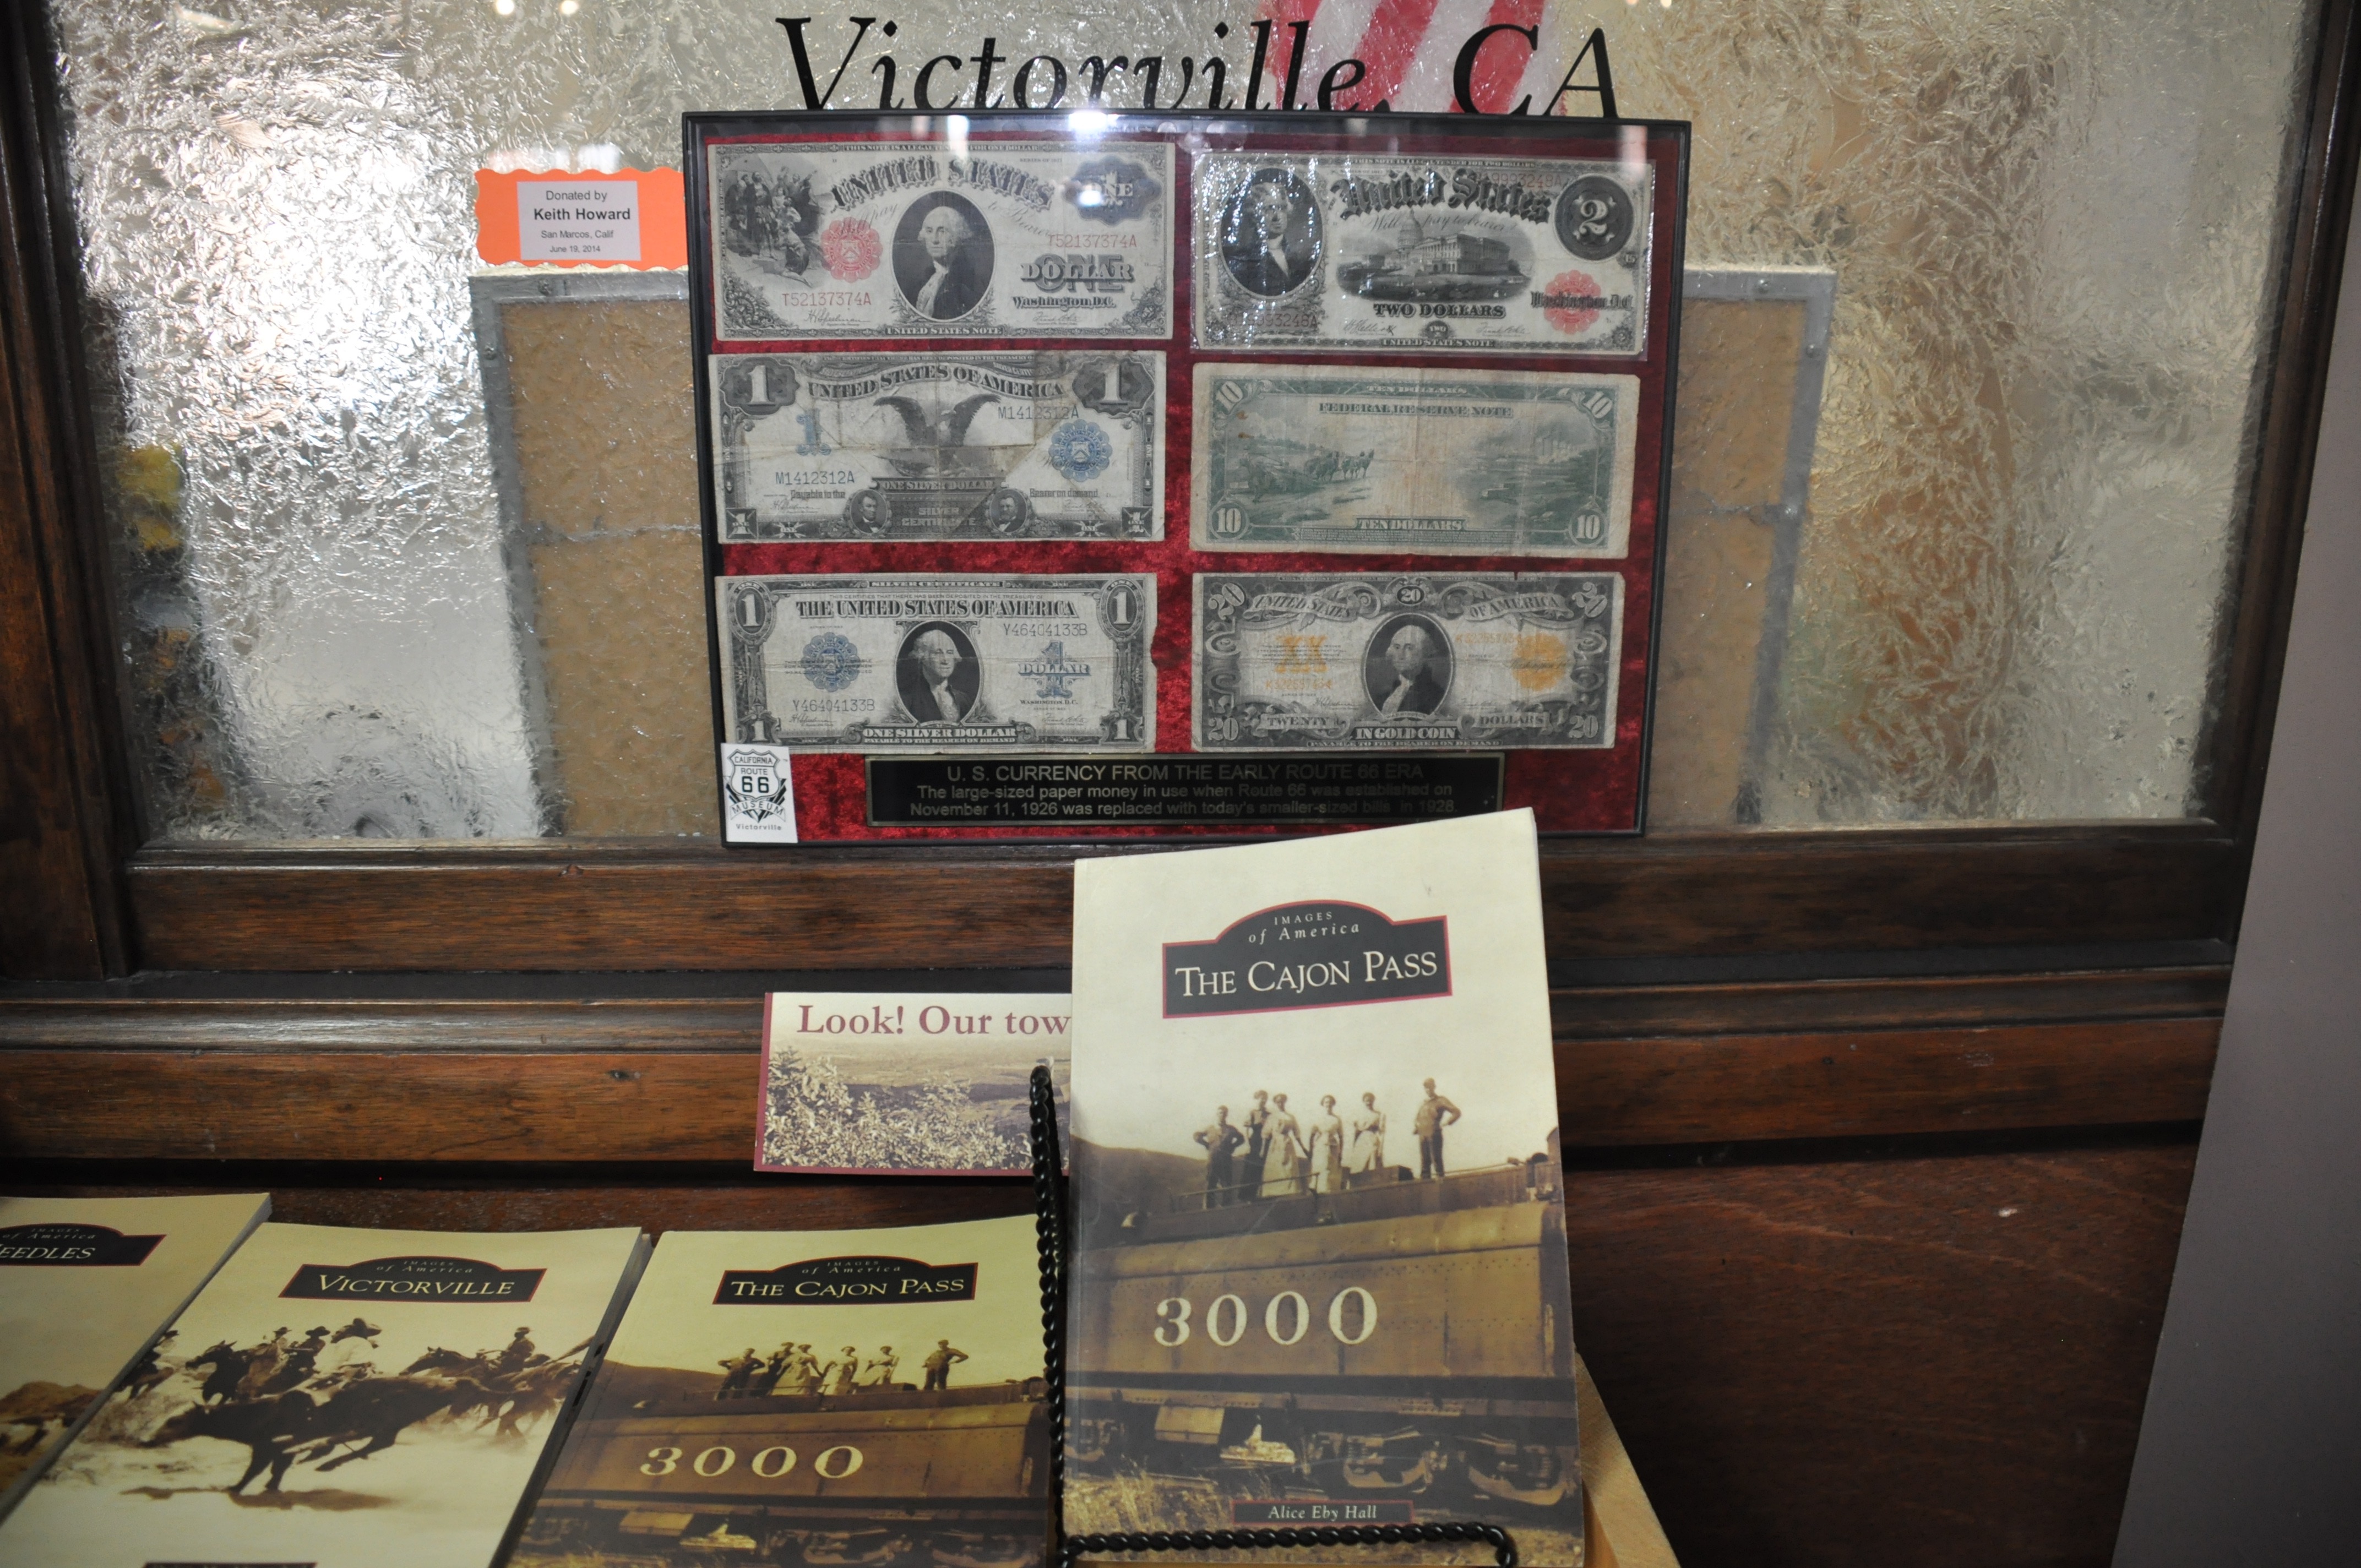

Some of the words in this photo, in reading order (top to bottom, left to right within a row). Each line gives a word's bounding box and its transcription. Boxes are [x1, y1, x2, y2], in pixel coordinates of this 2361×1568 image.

[1454, 24, 1620, 117] CA
[831, 155, 942, 214] UNITED
[546, 190, 591, 200] Donated
[594, 190, 607, 202] by
[534, 208, 570, 220] Keith
[575, 208, 631, 220] Howard
[1578, 199, 1608, 236] 2
[541, 230, 558, 238] San
[559, 230, 592, 239] Marcos,
[595, 230, 614, 238] Calif
[1047, 234, 1137, 248] T52137374A
[569, 245, 580, 253] 19,
[1020, 263, 1136, 283] DOLLAR
[1034, 253, 1125, 293] ONE
[782, 292, 872, 307] T52137374A
[1373, 303, 1416, 318] TWO
[1419, 304, 1506, 319] DOLLARS
[1423, 339, 1464, 347] STATES
[747, 364, 775, 406] 1
[807, 379, 876, 398] UNITED
[880, 364, 951, 388] STATES
[953, 367, 980, 384] OF
[980, 373, 1065, 398] AMERICA
[1100, 364, 1128, 406] 1
[1216, 380, 1244, 408] 10
[998, 406, 1079, 420] M1412312A
[1319, 403, 1391, 414] FEDERAL
[1393, 404, 1470, 417] RESERVE
[1471, 406, 1514, 418] NOTE
[1583, 391, 1613, 419] 10
[775, 470, 855, 485] M1412312A
[884, 481, 904, 489] ONE
[906, 481, 946, 489] SILVER
[918, 507, 959, 515] SILVER
[1216, 508, 1242, 533] 10
[1360, 520, 1389, 529] TEN
[1392, 520, 1462, 530] DOLLARS
[1576, 514, 1600, 539] 10
[1208, 582, 1245, 620] 20
[1255, 595, 1307, 609] UNITED
[1400, 589, 1421, 602] 20
[1571, 581, 1608, 618] 20
[741, 594, 760, 627] 1
[796, 601, 834, 619] THE
[837, 600, 903, 618] UNITED
[905, 600, 970, 618] STATES
[971, 600, 995, 618] OF
[995, 600, 1080, 619] AMERICA
[1113, 591, 1130, 624] 1
[1469, 606, 1486, 618] OF
[1489, 596, 1560, 616] AMERICA
[1003, 623, 1087, 636] Y46404133B
[1018, 663, 1092, 677] DOLLAR
[793, 698, 875, 712] Y46404133B
[1113, 719, 1130, 740] 1
[1208, 717, 1239, 741] 20
[1268, 716, 1330, 728] TWENTY
[1479, 715, 1544, 726] DOLLARS
[1568, 715, 1598, 739] 20
[751, 721, 767, 742] 1
[862, 728, 894, 737] ONE
[895, 728, 953, 737] SILVER
[955, 728, 1018, 737] DOLLAR
[1355, 727, 1373, 739] IN
[1374, 727, 1417, 739] GOLD
[1417, 727, 1458, 739] COIN
[734, 756, 773, 764] CALIFORNIA
[947, 766, 966, 781] U.
[972, 766, 989, 781] S.
[995, 765, 1103, 782] CURRENCY
[1112, 765, 1168, 780] FROM
[1174, 765, 1212, 780] THE
[1218, 764, 1281, 780] EARLY
[1286, 764, 1353, 780] ROUTE
[1358, 764, 1379, 779] 66
[1385, 764, 1424, 779] ERA
[741, 776, 769, 793] 66
[917, 786, 946, 799] The
[951, 785, 1035, 802] large-sized
[1040, 788, 1081, 802] paper
[1087, 788, 1138, 802] money
[1143, 785, 1156, 798] in
[1161, 788, 1189, 798] use
[1195, 785, 1233, 797] when
[1239, 785, 1282, 797] Route
[1287, 785, 1306, 797] 66
[1310, 787, 1341, 797] was
[1345, 784, 1429, 797] established
[1434, 786, 1452, 796] on
[731, 801, 784, 815] MUSEUM
[911, 802, 988, 816] November
[994, 802, 1015, 818] 11,
[1021, 802, 1058, 815] 1926
[1063, 805, 1093, 815] was
[1097, 802, 1162, 818] replaced
[1167, 801, 1197, 814] with
[1202, 801, 1255, 816] today's
[1259, 800, 1357, 814] smaller-sized
[1363, 800, 1391, 813] bills
[1400, 800, 1413, 813] in
[1274, 911, 1332, 925] IMAGES
[1248, 929, 1266, 944] of
[1279, 923, 1359, 941] America
[1174, 967, 1237, 997] THE
[1247, 960, 1351, 993] CAJON
[1363, 950, 1438, 983] PASS
[796, 1005, 904, 1034] Look!
[919, 1005, 993, 1034] Our
[0, 1243, 96, 1259] EEDLES
[401, 1265, 474, 1273] America
[802, 1267, 818, 1275] of
[828, 1265, 902, 1274] America
[319, 1274, 515, 1295] VICTORVILLE
[731, 1281, 784, 1296] THE
[795, 1281, 888, 1298] CAJON
[899, 1278, 965, 1295] PASS
[1154, 1286, 1378, 1347] 3000
[639, 1445, 864, 1479] 3000
[1268, 1505, 1305, 1519] Alice
[1312, 1505, 1339, 1522] Eby
[1345, 1505, 1377, 1519] Hall
